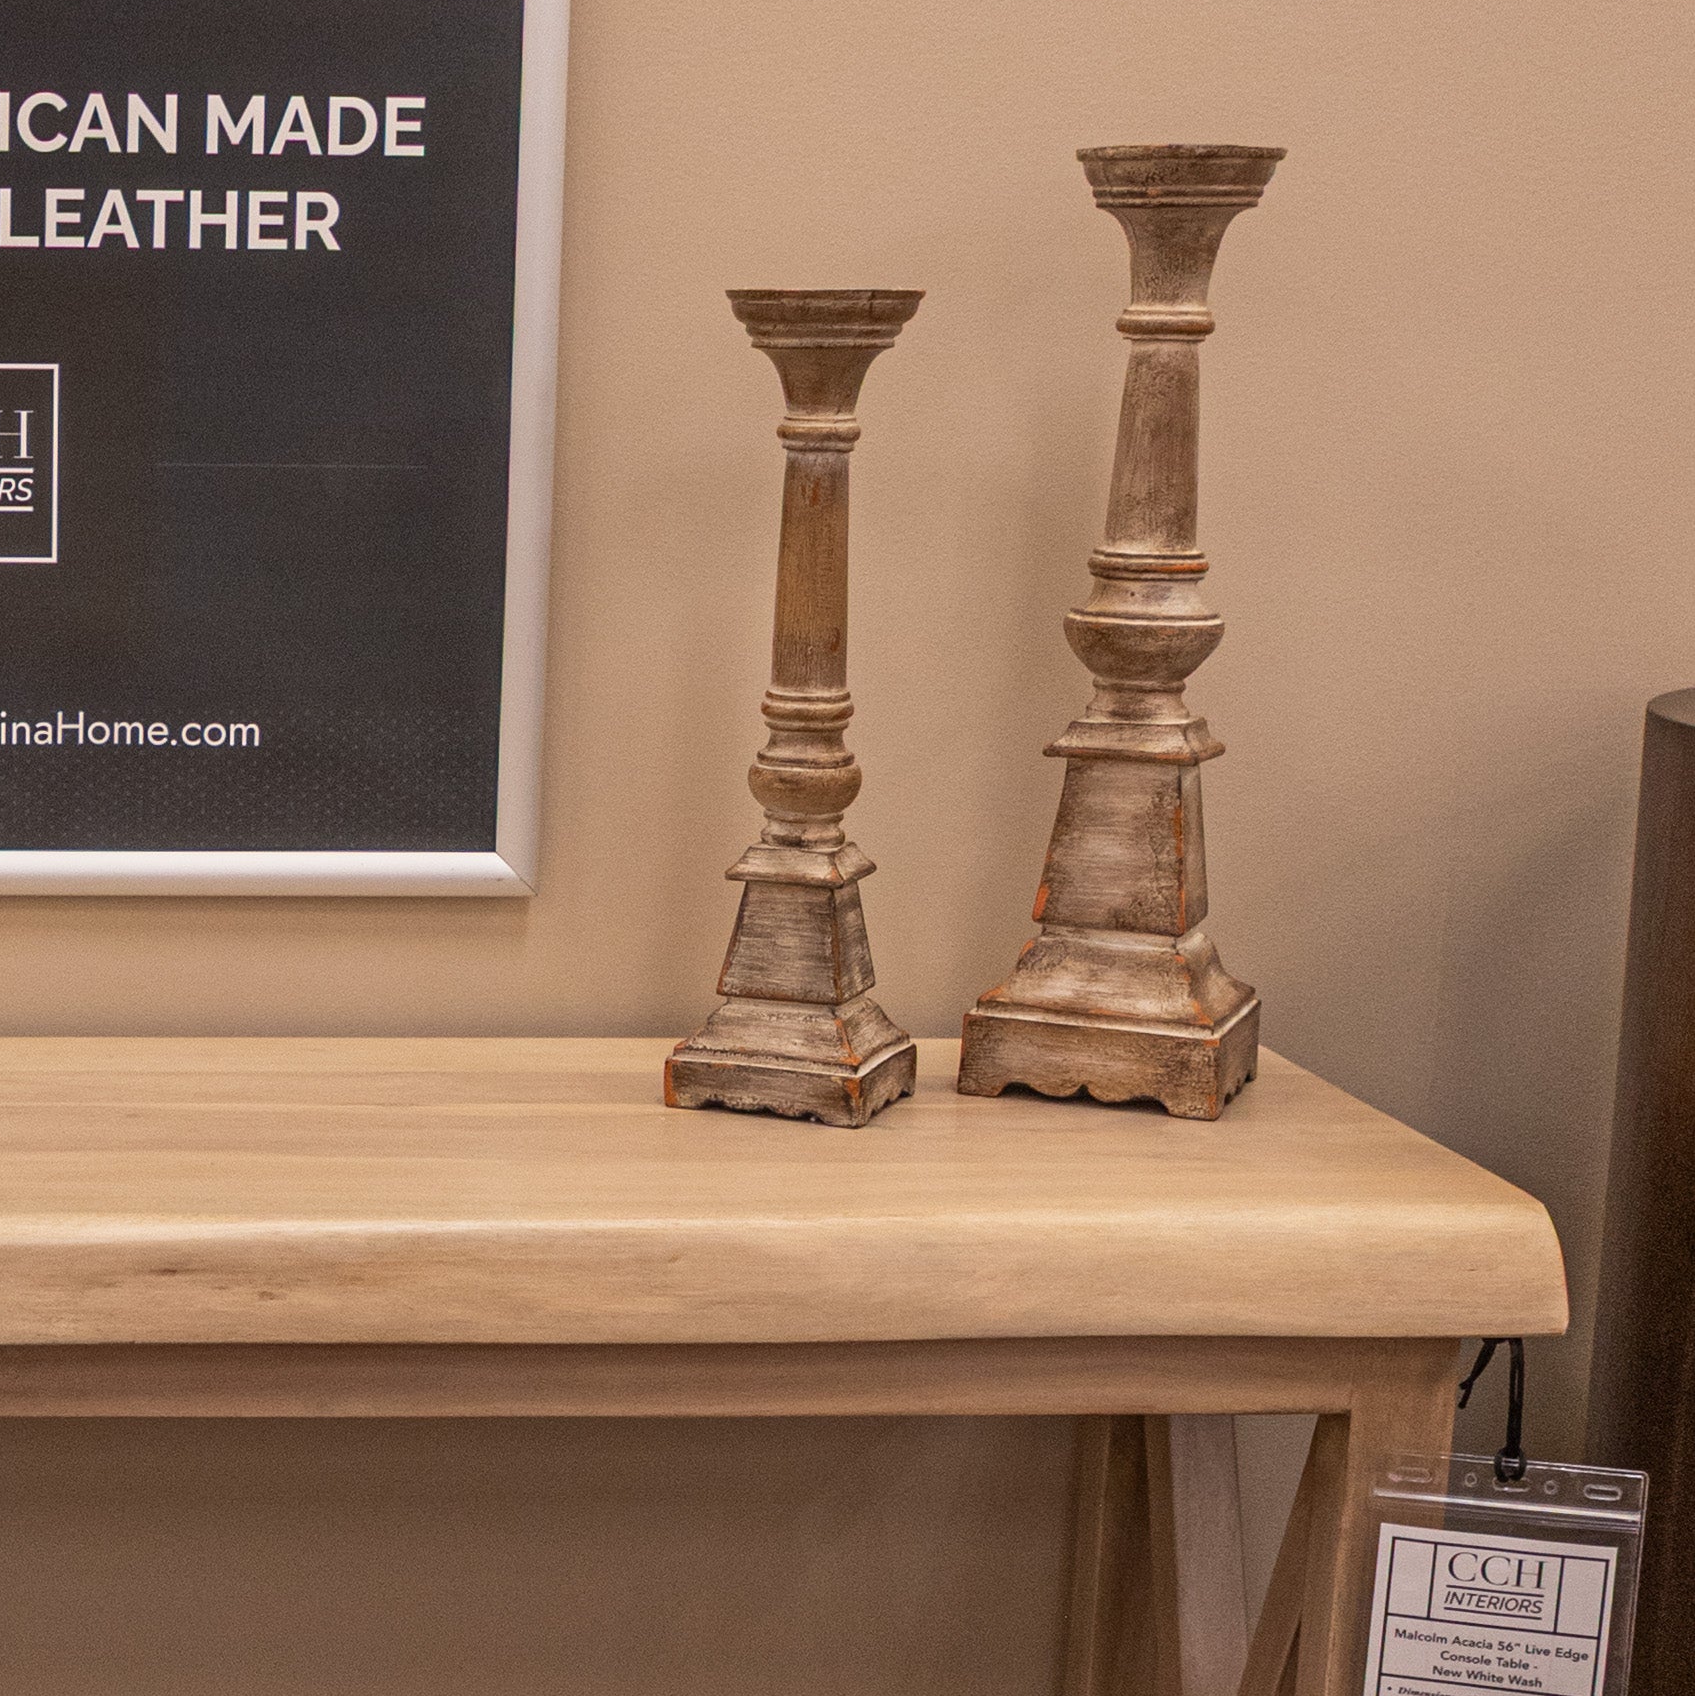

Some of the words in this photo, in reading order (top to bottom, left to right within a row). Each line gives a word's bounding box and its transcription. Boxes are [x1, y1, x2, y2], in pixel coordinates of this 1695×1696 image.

[204, 93, 427, 158] MADE
[1448, 1551, 1548, 1590] CCH
[1444, 1591, 1544, 1614] INTERIORS
[1394, 1628, 1448, 1645] Malcolm
[1451, 1635, 1493, 1651] Acacia
[1525, 1644, 1551, 1657] Live
[1554, 1647, 1590, 1663] Edge
[1440, 1650, 1492, 1667] Console
[1495, 1656, 1530, 1671] Table
[1432, 1665, 1462, 1679] New
[1465, 1669, 1505, 1684] White
[1508, 1674, 1543, 1689] Wash
